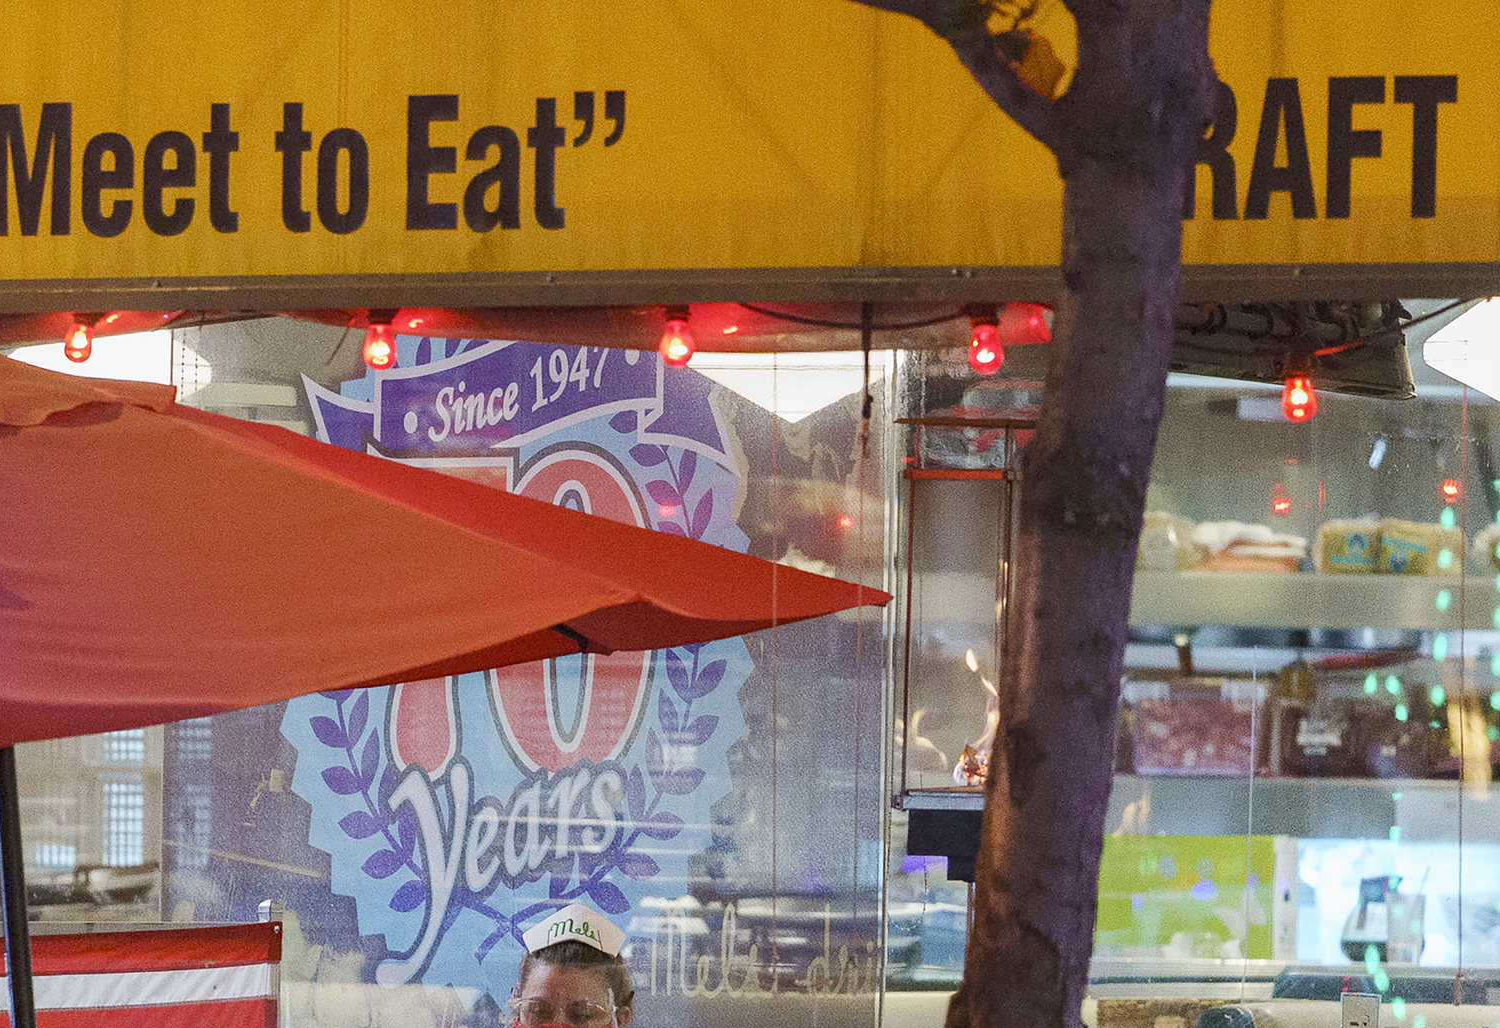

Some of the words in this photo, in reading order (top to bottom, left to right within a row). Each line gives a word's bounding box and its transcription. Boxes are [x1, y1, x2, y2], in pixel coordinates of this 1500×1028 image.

[275, 102, 369, 235] to
[405, 91, 626, 233] Eat”
[428, 380, 520, 442] Since
[528, 345, 611, 413] 1947
[375, 768, 624, 986] Years
[550, 918, 598, 942] Mels
